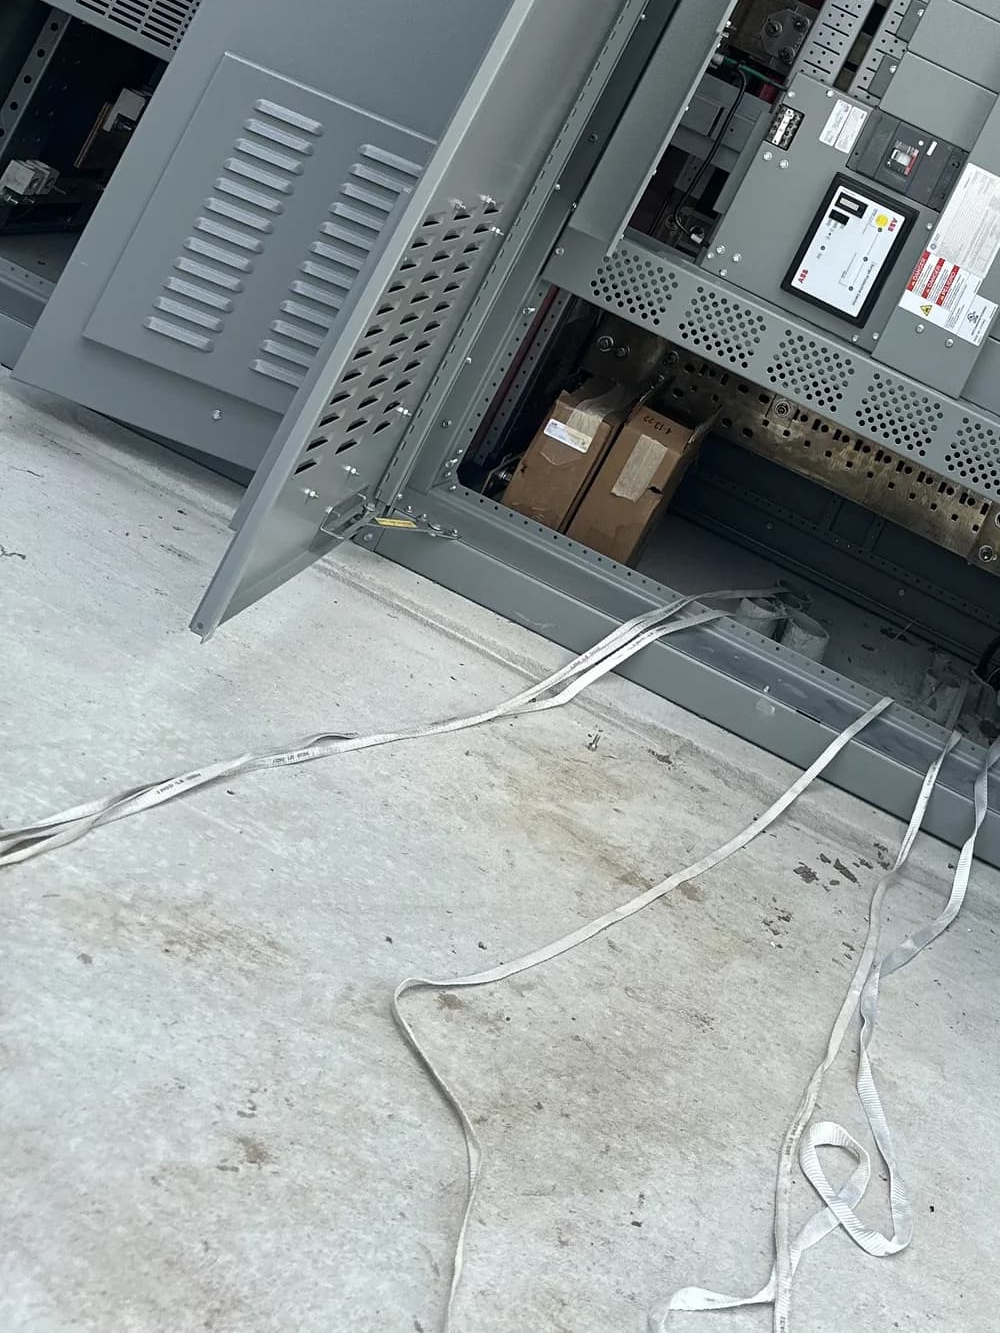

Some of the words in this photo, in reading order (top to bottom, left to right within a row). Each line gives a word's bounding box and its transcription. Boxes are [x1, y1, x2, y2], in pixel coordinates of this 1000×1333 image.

[886, 217, 898, 232] ABB
[797, 268, 809, 284] ABB
[911, 257, 926, 280] DANGER
[926, 264, 941, 288] DANGER
[941, 271, 956, 295] PELIGRO
